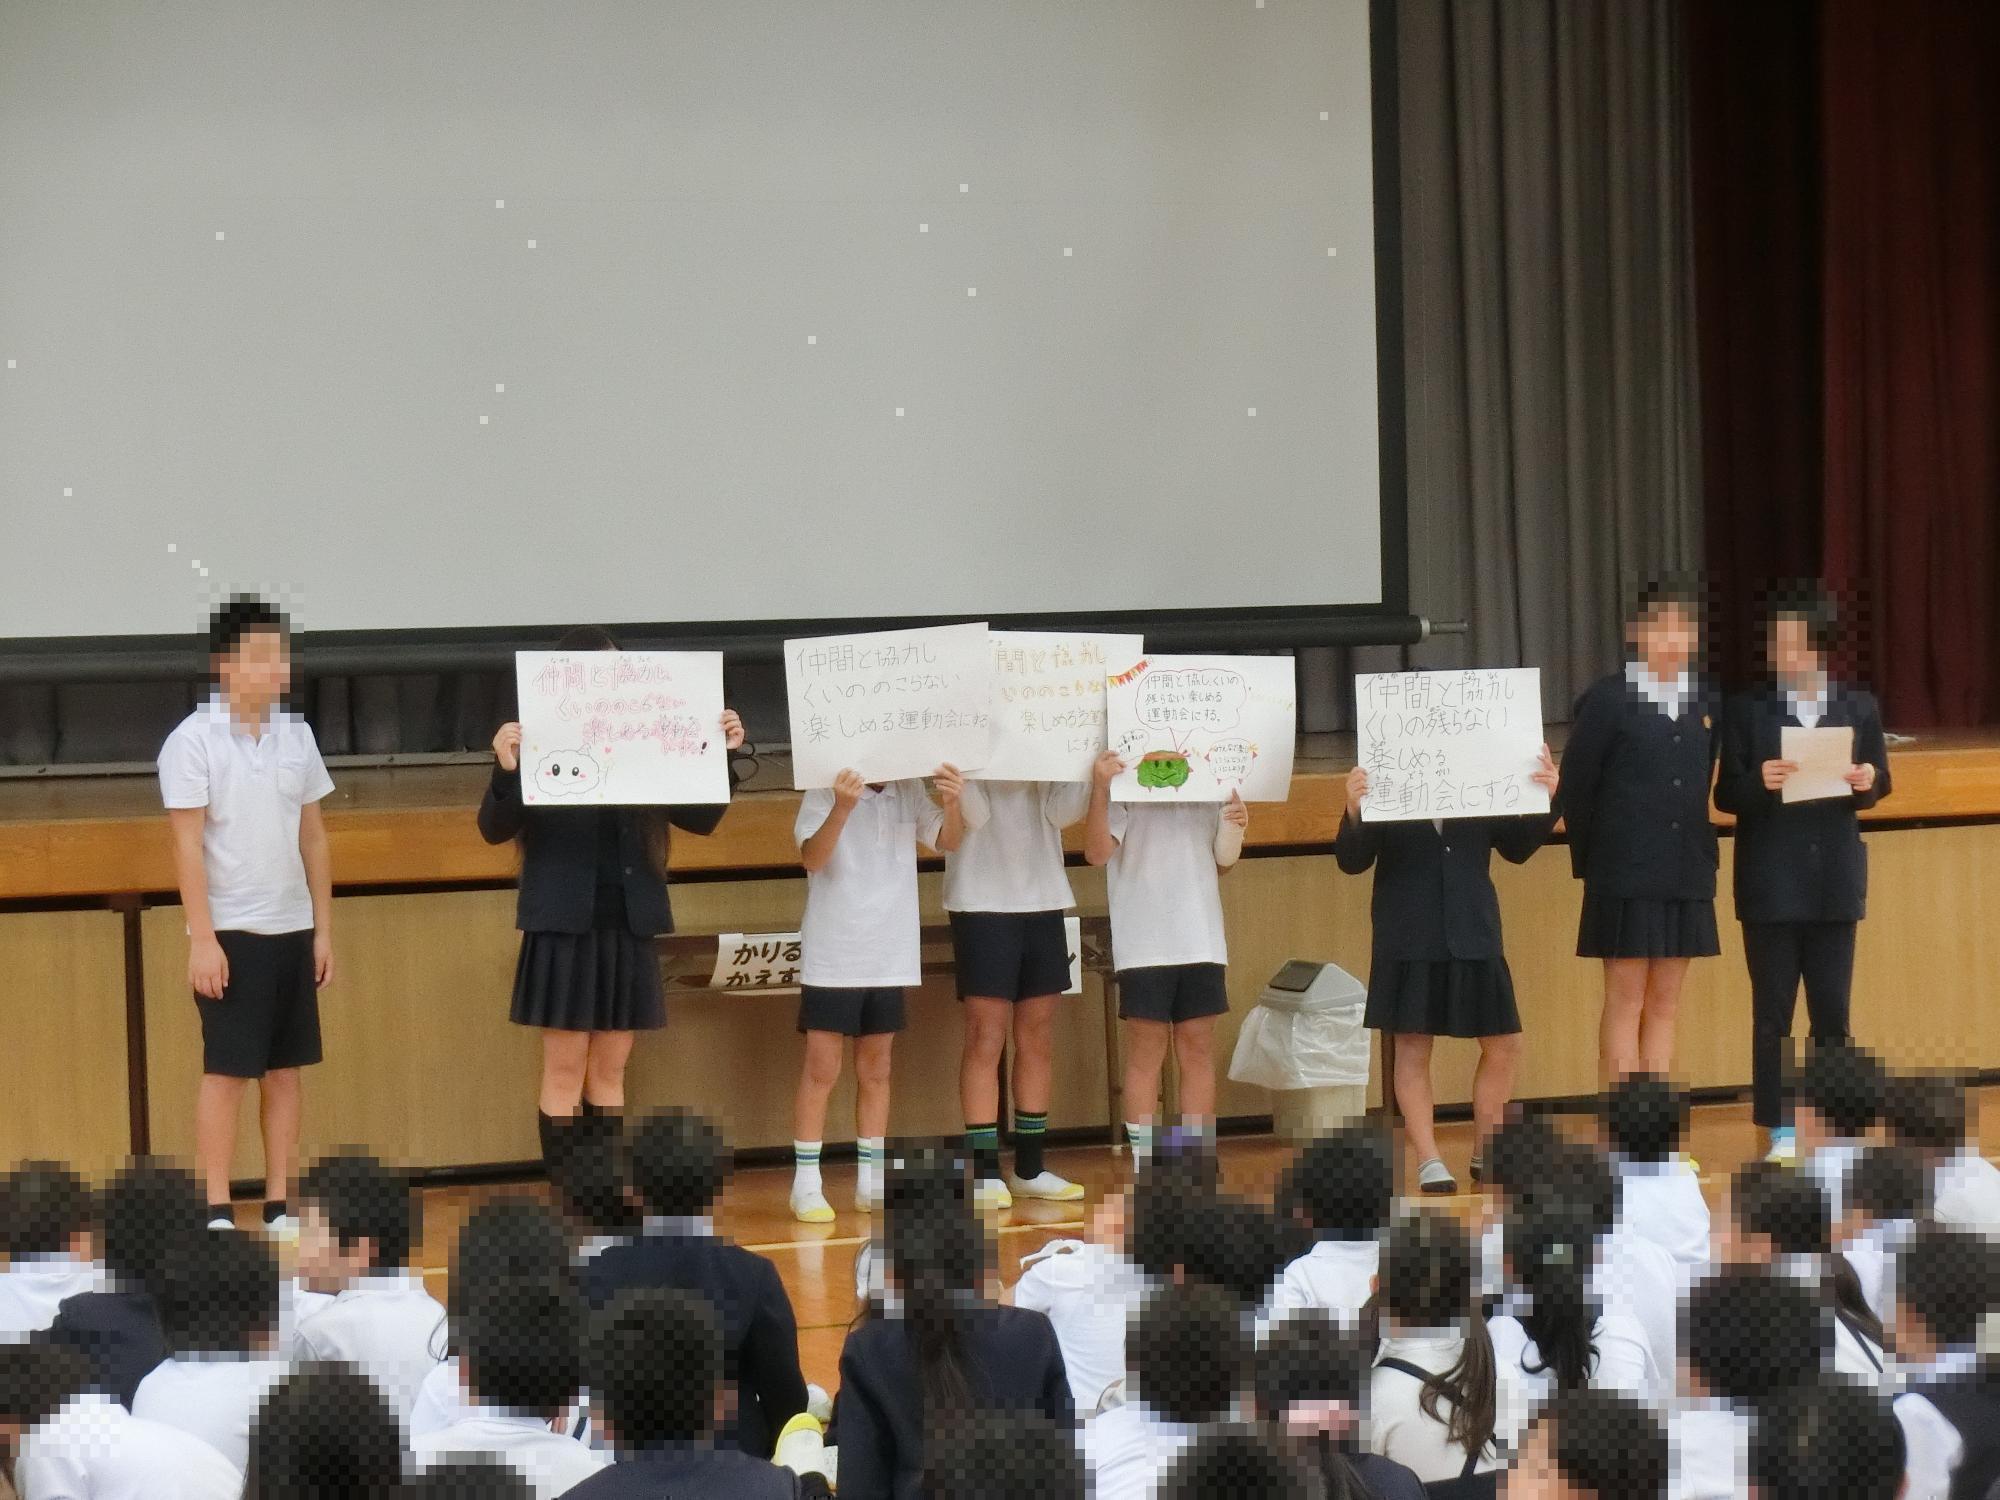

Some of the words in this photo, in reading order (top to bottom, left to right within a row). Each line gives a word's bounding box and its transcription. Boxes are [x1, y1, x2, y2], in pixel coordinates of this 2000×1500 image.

[797, 643, 937, 677] 仲間と協力し
[803, 673, 961, 708] くいののこらない
[1363, 675, 1514, 710] 仲間と協力し
[1365, 705, 1508, 742] くいの残らない
[1365, 746, 1447, 774] 楽しめる
[1363, 773, 1521, 816] 運動会にする
[732, 940, 802, 966] かりる
[725, 966, 801, 987] かえす
